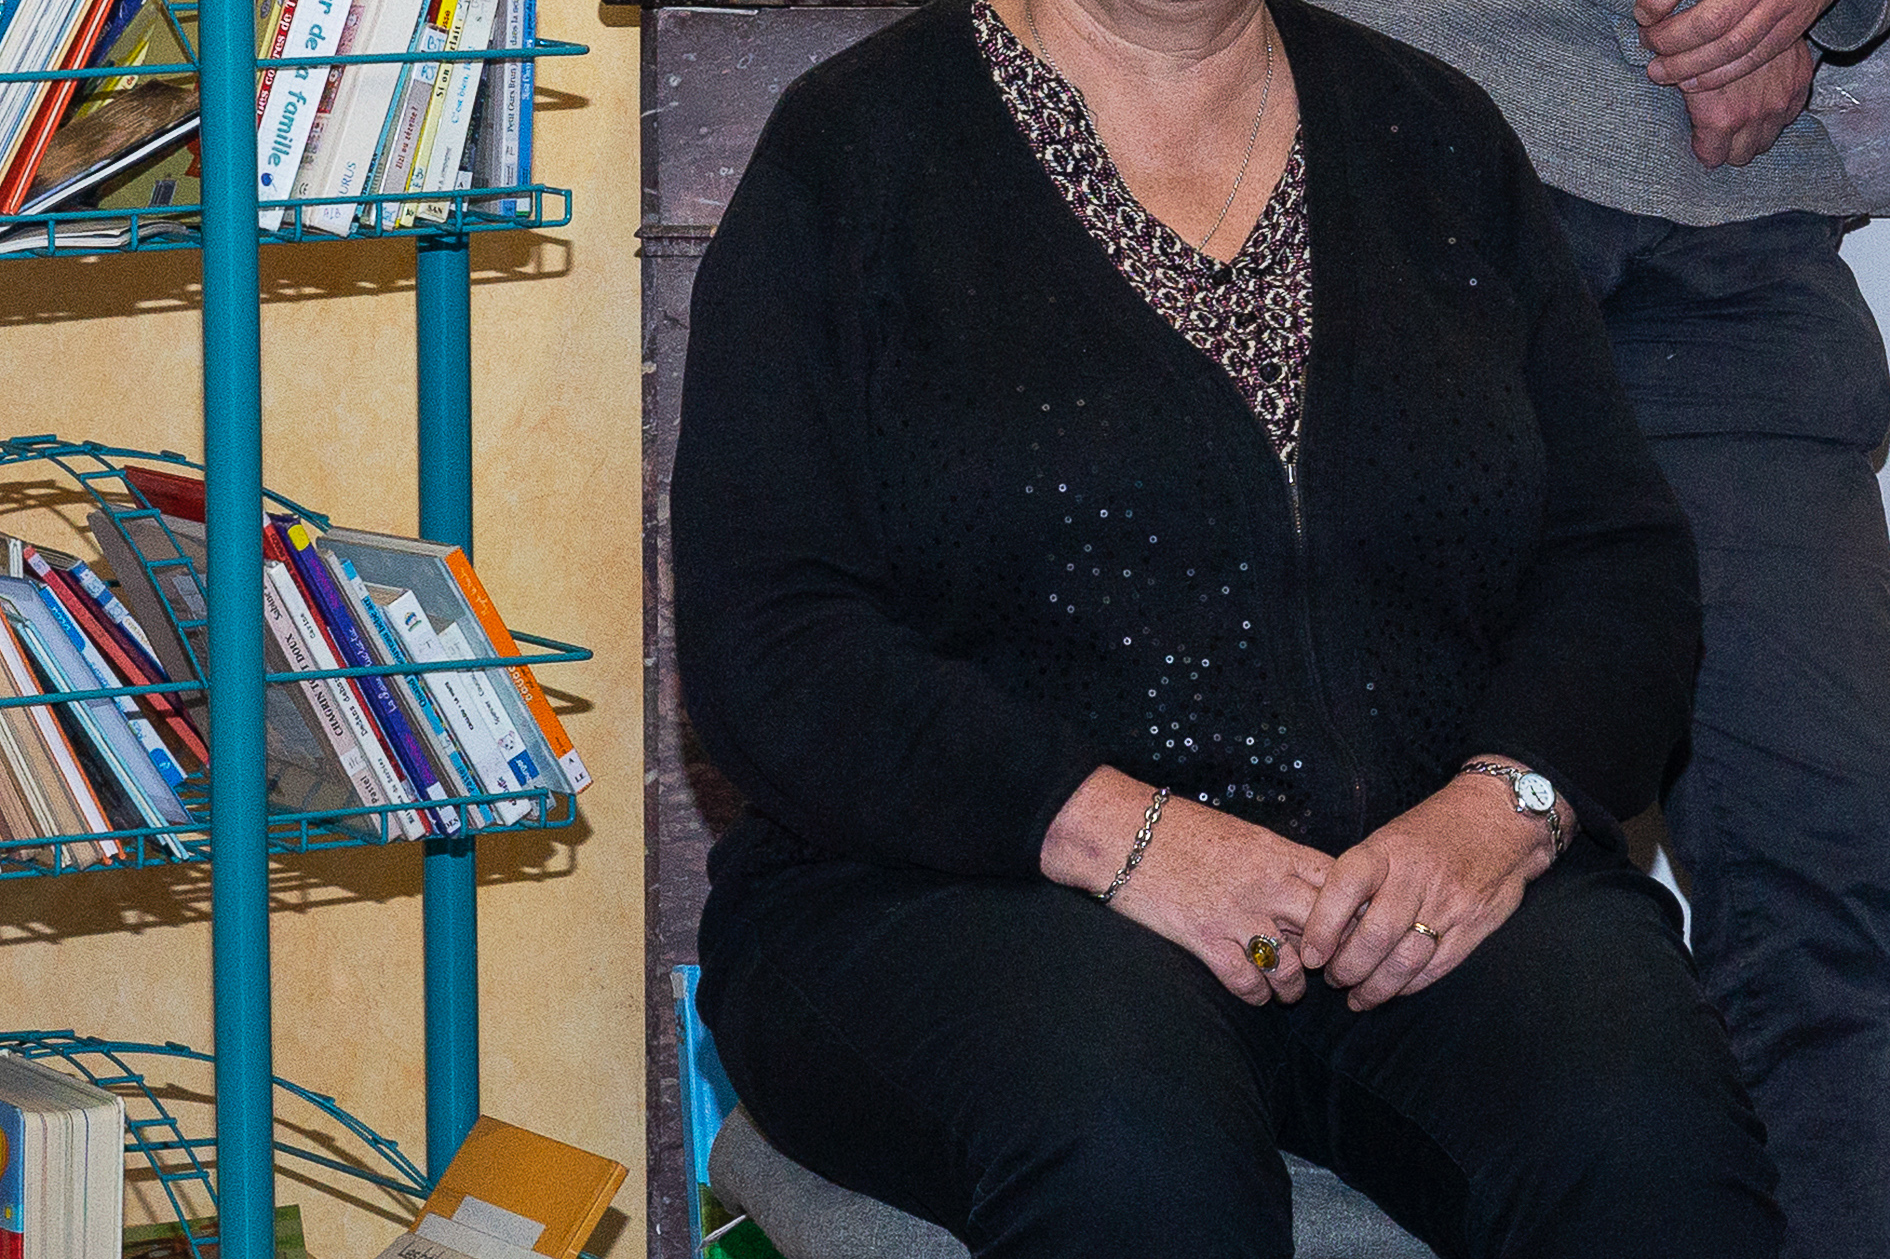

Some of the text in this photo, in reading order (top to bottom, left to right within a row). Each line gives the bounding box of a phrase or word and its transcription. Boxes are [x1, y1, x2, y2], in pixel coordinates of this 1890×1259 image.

[303, 22, 329, 54] de
[434, 85, 446, 98] Si
[440, 68, 451, 83] on
[508, 68, 517, 88] Brun
[262, 86, 311, 170] famille
[506, 112, 515, 132] Petit
[283, 631, 305, 663] DOUX
[299, 661, 320, 691] TOT
[314, 689, 345, 738] CHAGRIN
[332, 675, 368, 736] Dedans dehor
[358, 774, 380, 805] Pastel
